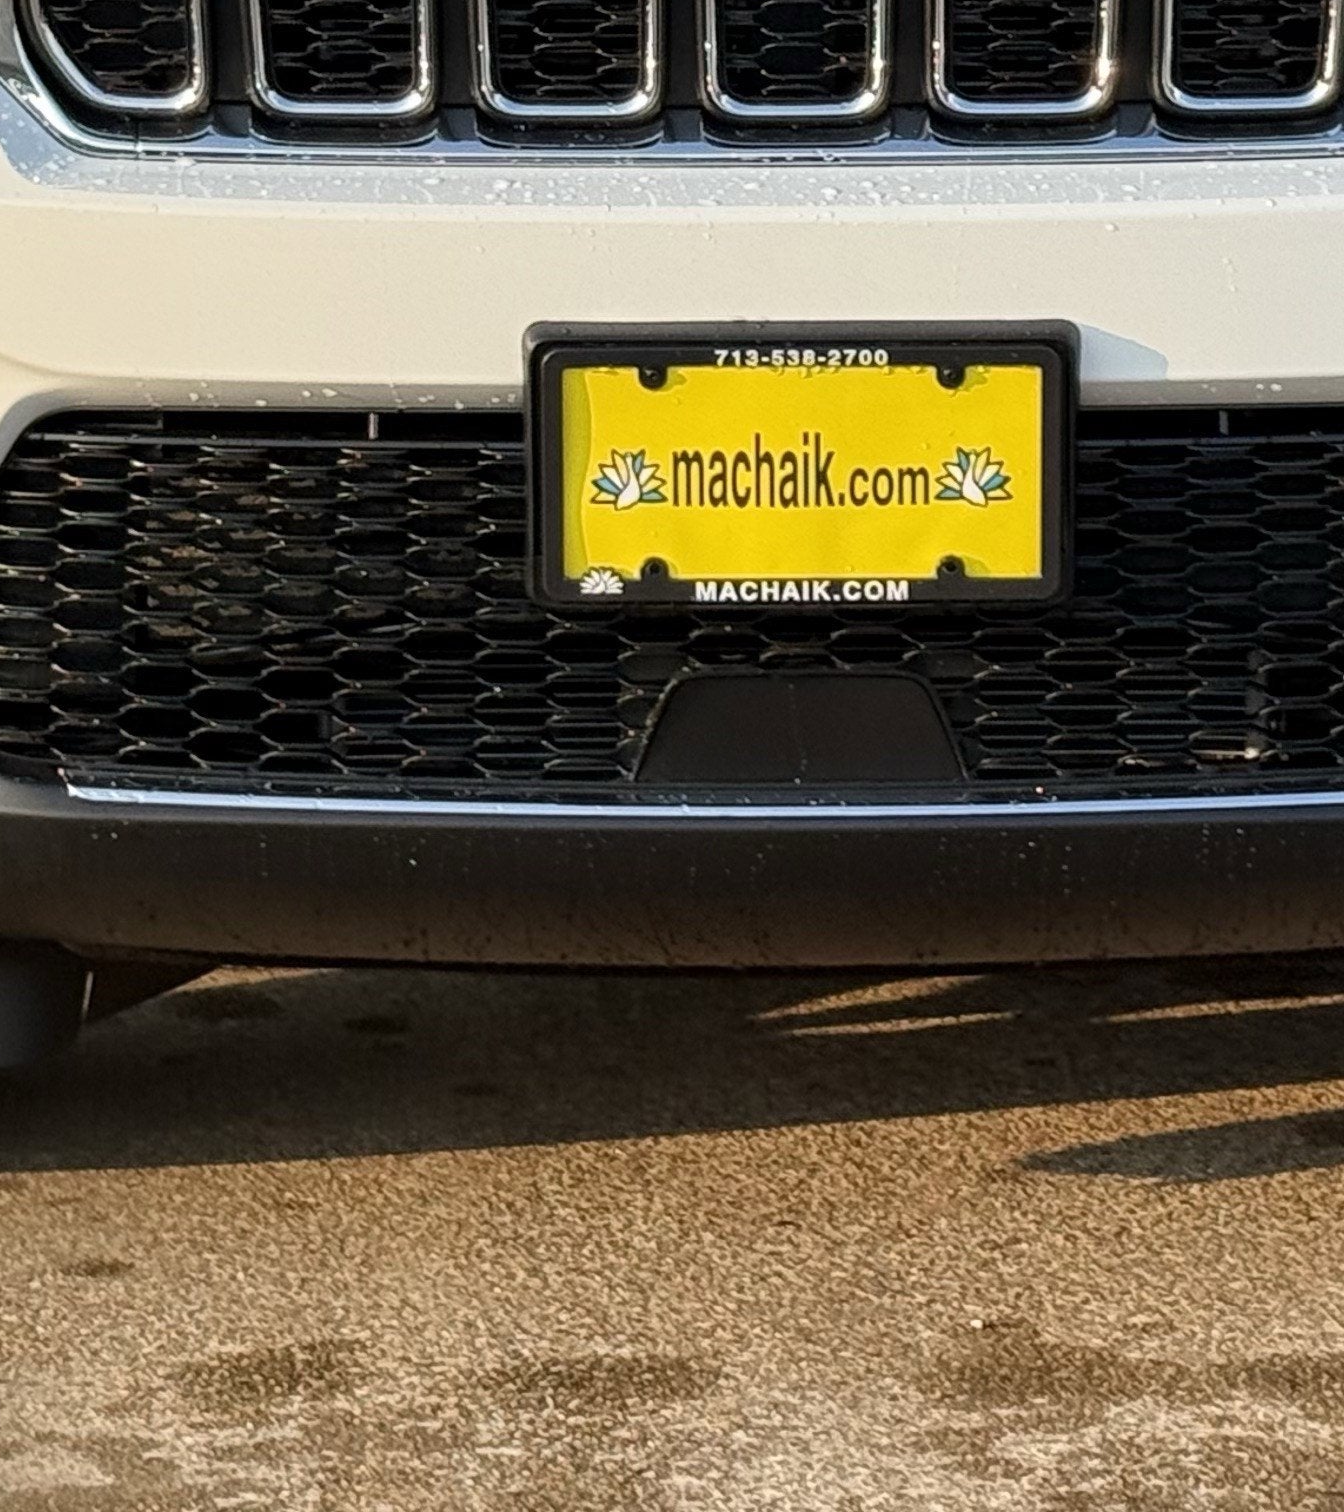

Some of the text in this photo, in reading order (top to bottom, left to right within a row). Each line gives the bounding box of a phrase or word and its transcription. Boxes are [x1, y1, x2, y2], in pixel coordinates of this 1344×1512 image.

[714, 349, 889, 367] 713-538-2700
[672, 432, 930, 509] machaik.com
[694, 581, 910, 603] MACHAIK.COM
